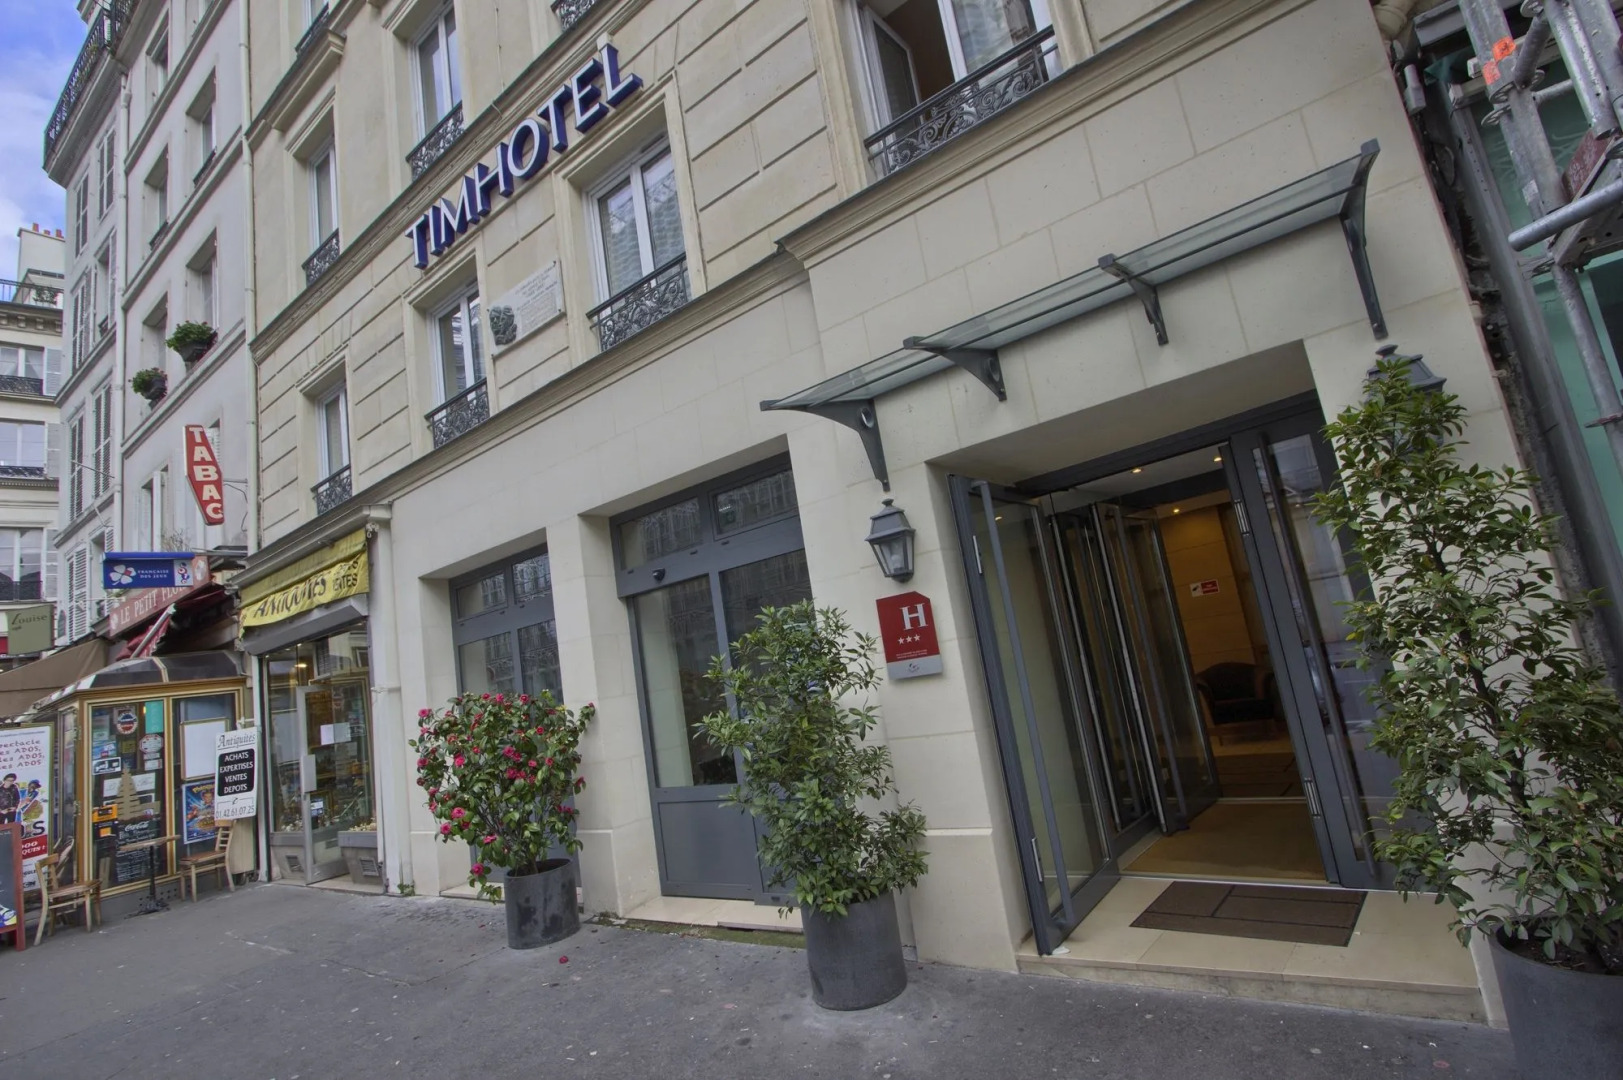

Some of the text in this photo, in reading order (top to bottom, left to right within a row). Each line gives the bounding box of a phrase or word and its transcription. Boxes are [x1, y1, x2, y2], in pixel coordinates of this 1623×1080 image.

[405, 43, 644, 270] TIMHOTEL
[189, 427, 224, 519] TABAC
[120, 605, 131, 625] LE
[134, 590, 158, 618] PETIT
[11, 612, 48, 625] Louise
[900, 603, 929, 631] H
[224, 751, 249, 762] ACHATS
[219, 761, 254, 774] EXPERTISES
[224, 773, 248, 783] VENTES
[223, 783, 248, 794] DEPOTS
